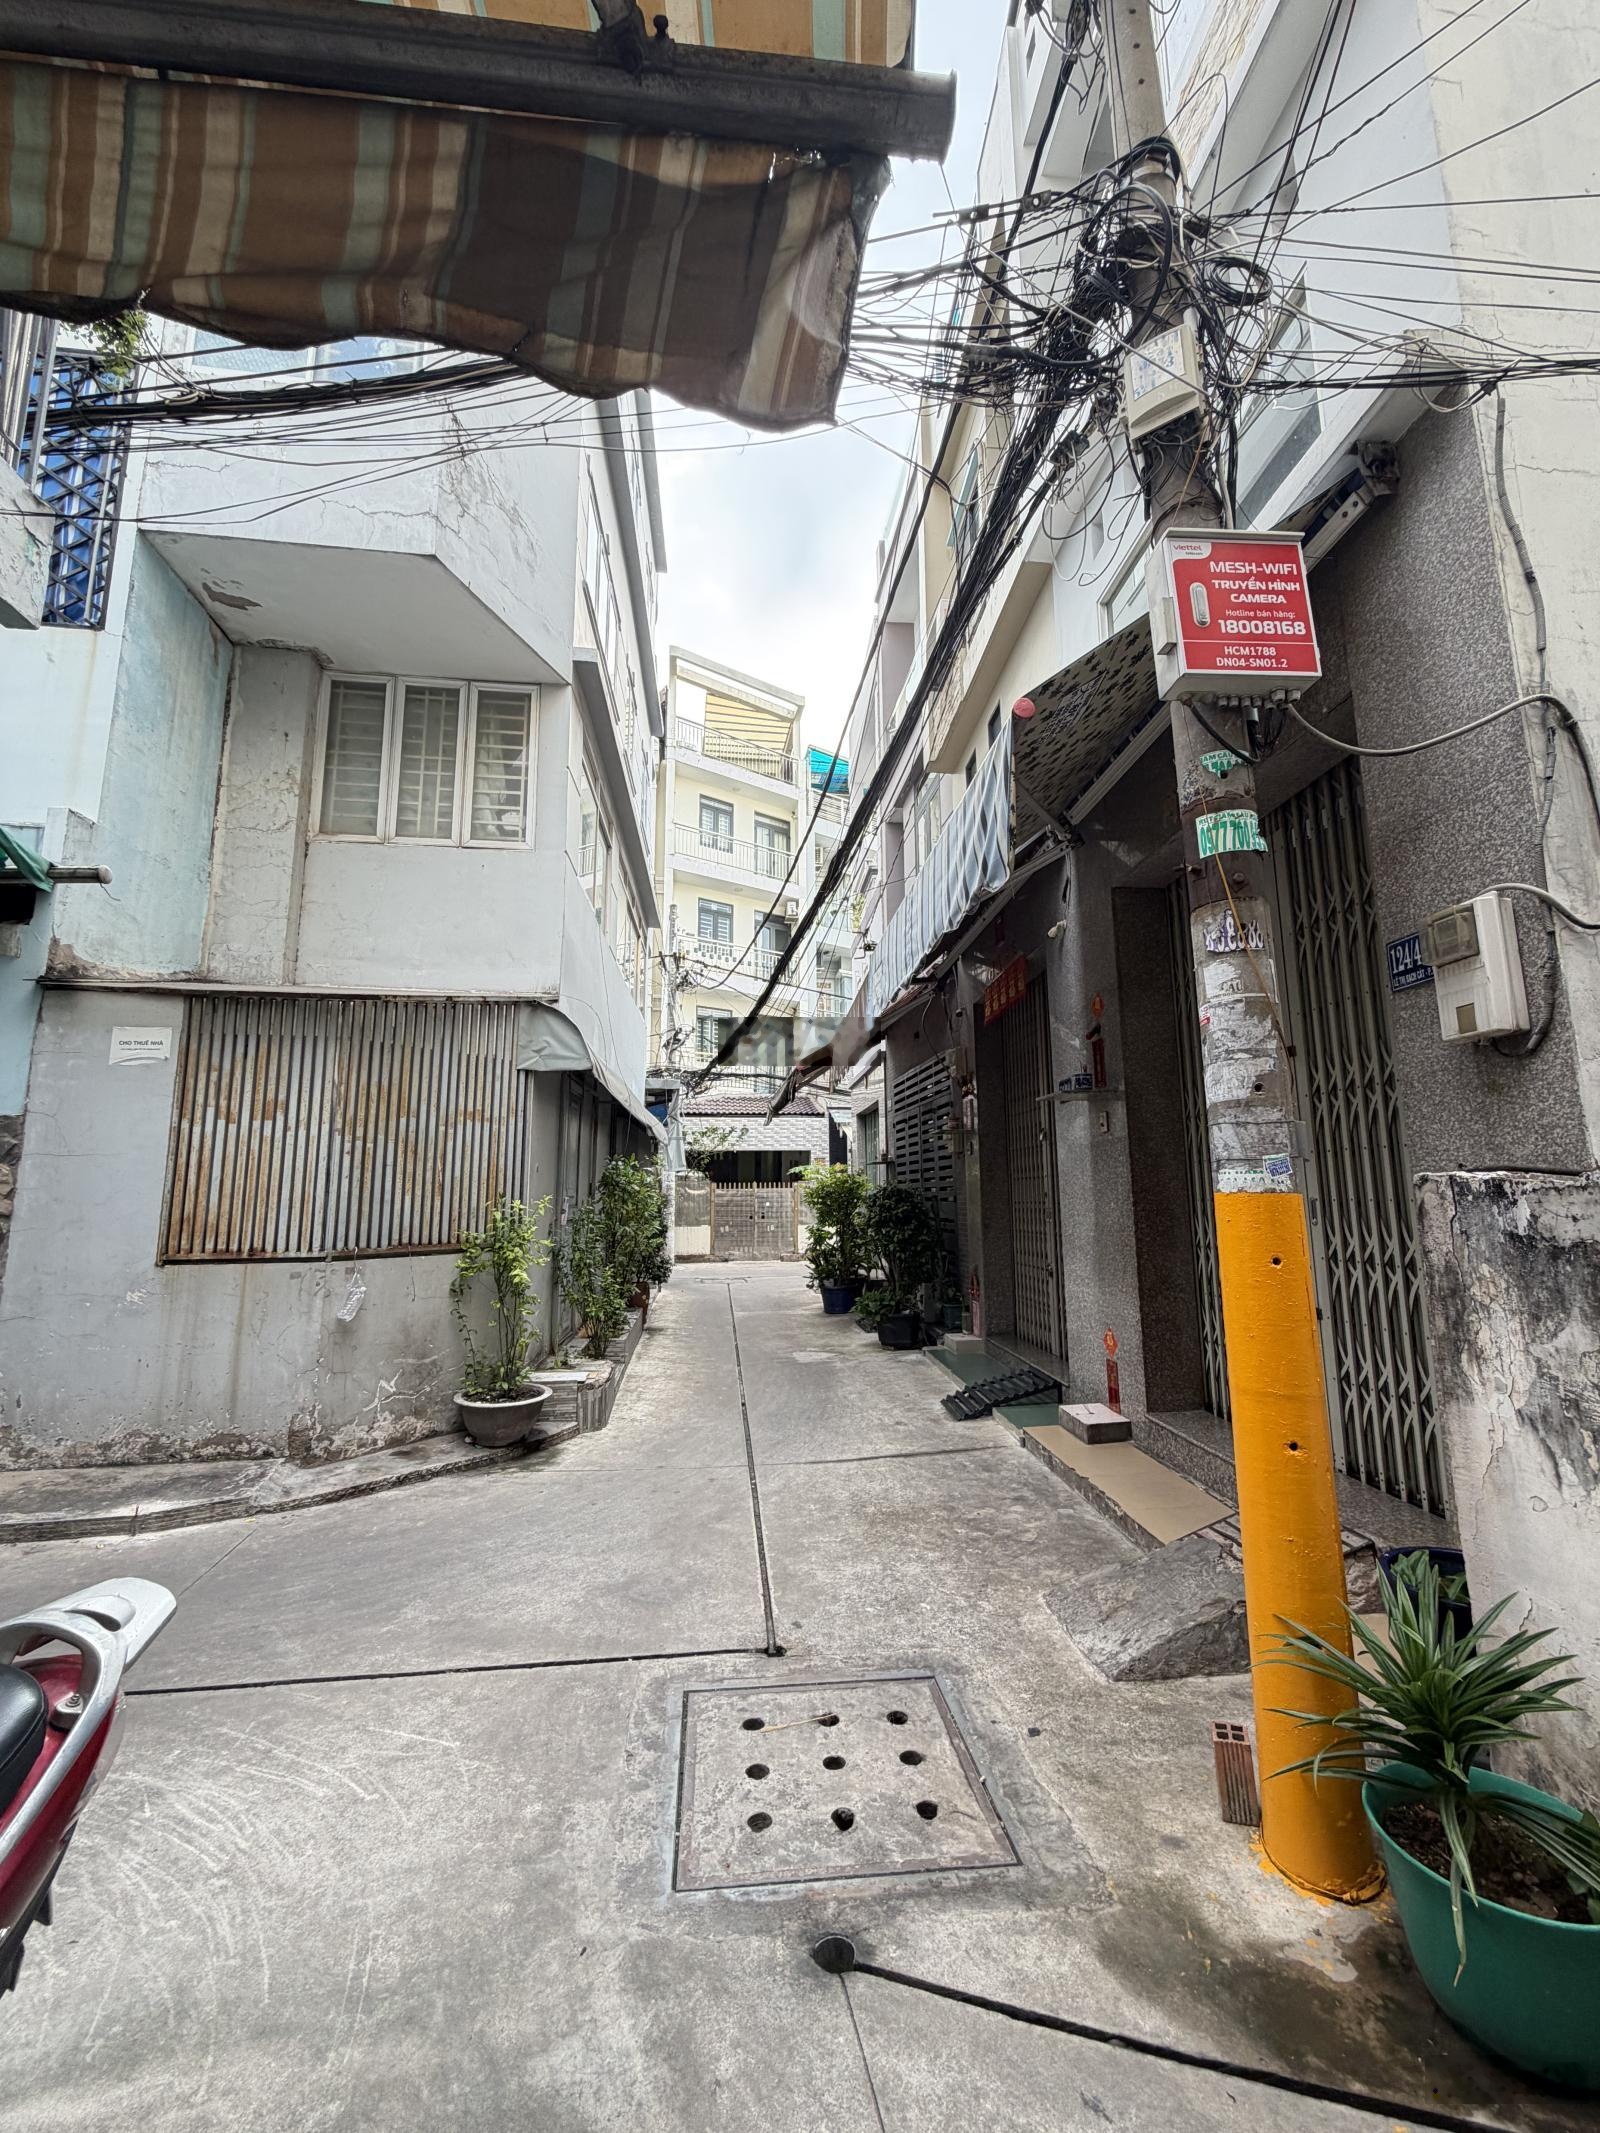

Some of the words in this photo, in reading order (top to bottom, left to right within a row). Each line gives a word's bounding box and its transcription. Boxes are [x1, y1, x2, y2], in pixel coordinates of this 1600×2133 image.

[1210, 561, 1297, 575] MESH-WIFI
[1212, 577, 1266, 590] TRUYỀN
[1268, 580, 1300, 591] HÌNH
[1230, 593, 1286, 604] CAMERA
[1225, 609, 1255, 617] Hotline
[1256, 610, 1272, 618] bán
[1273, 611, 1296, 619] hàng:
[1218, 620, 1306, 635] 18008168
[1224, 646, 1276, 656] HCM1788
[1216, 658, 1288, 669] DN04-SN01.2
[1390, 939, 1422, 973] 124/4
